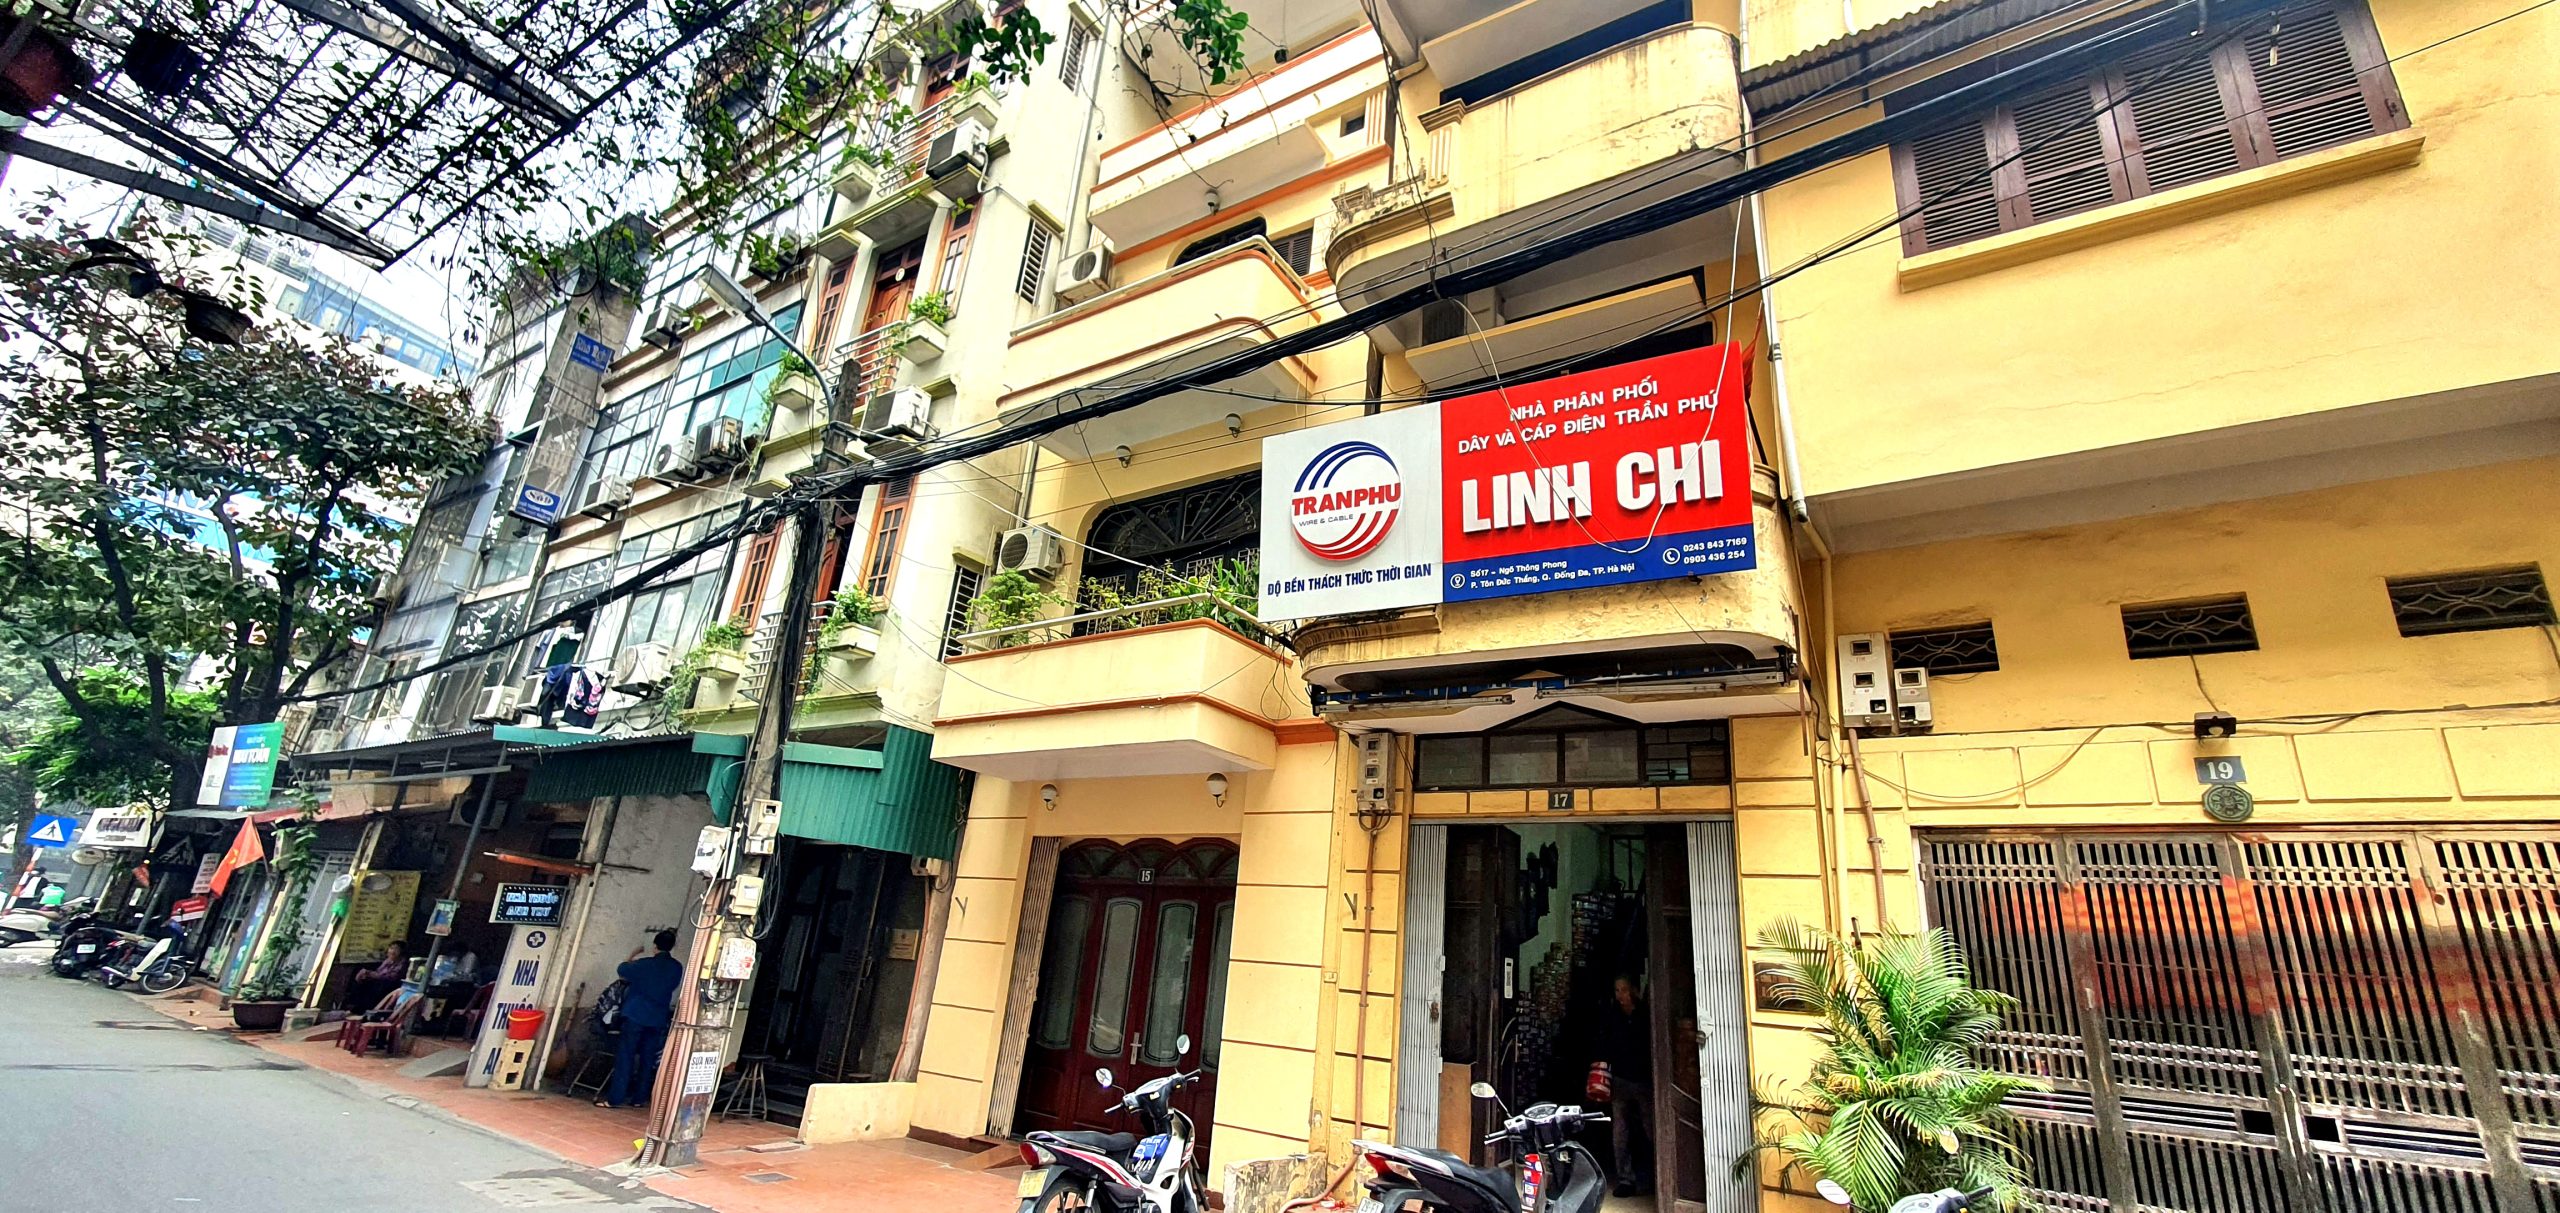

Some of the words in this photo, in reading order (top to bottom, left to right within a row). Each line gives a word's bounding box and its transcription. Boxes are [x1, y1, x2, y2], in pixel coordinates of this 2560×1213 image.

[1510, 400, 1546, 421] NHÀ
[1553, 390, 1604, 413] PHÂN
[1612, 375, 1659, 402] PHỐI
[1458, 434, 1490, 455] DÂY
[1495, 426, 1516, 447] VÀ
[1521, 421, 1557, 442] CÁP
[1563, 414, 1606, 436] ĐIỆN
[1614, 400, 1668, 426] TRẦN
[1678, 389, 1718, 415] PHÚ
[1461, 461, 1592, 533] LINH
[1616, 439, 1723, 510] CHI
[1291, 482, 1402, 516] TRANPHU
[1299, 519, 1318, 527] WIRE
[1327, 514, 1354, 523] CABLE
[1683, 542, 1705, 552] 0243
[1707, 540, 1724, 549] 843
[1726, 537, 1747, 547] 7169
[1542, 560, 1567, 571] Phong
[1683, 555, 1706, 564] 0903
[1708, 552, 1725, 561] 436
[1727, 550, 1745, 559] 254
[1267, 580, 1281, 597] ĐỘ
[1308, 573, 1342, 591] THÁCH
[1345, 568, 1373, 586] THỨC
[1376, 566, 1400, 582] THỜI
[1404, 563, 1432, 579] GIAN
[1470, 581, 1478, 589] P.
[1593, 566, 1605, 575] TP.
[1607, 563, 1619, 573] Hà
[1620, 562, 1635, 573] Nội
[2206, 761, 2233, 780] 19
[1553, 793, 1568, 807] 17
[1141, 870, 1151, 882] 15
[511, 954, 541, 986] NHÀ
